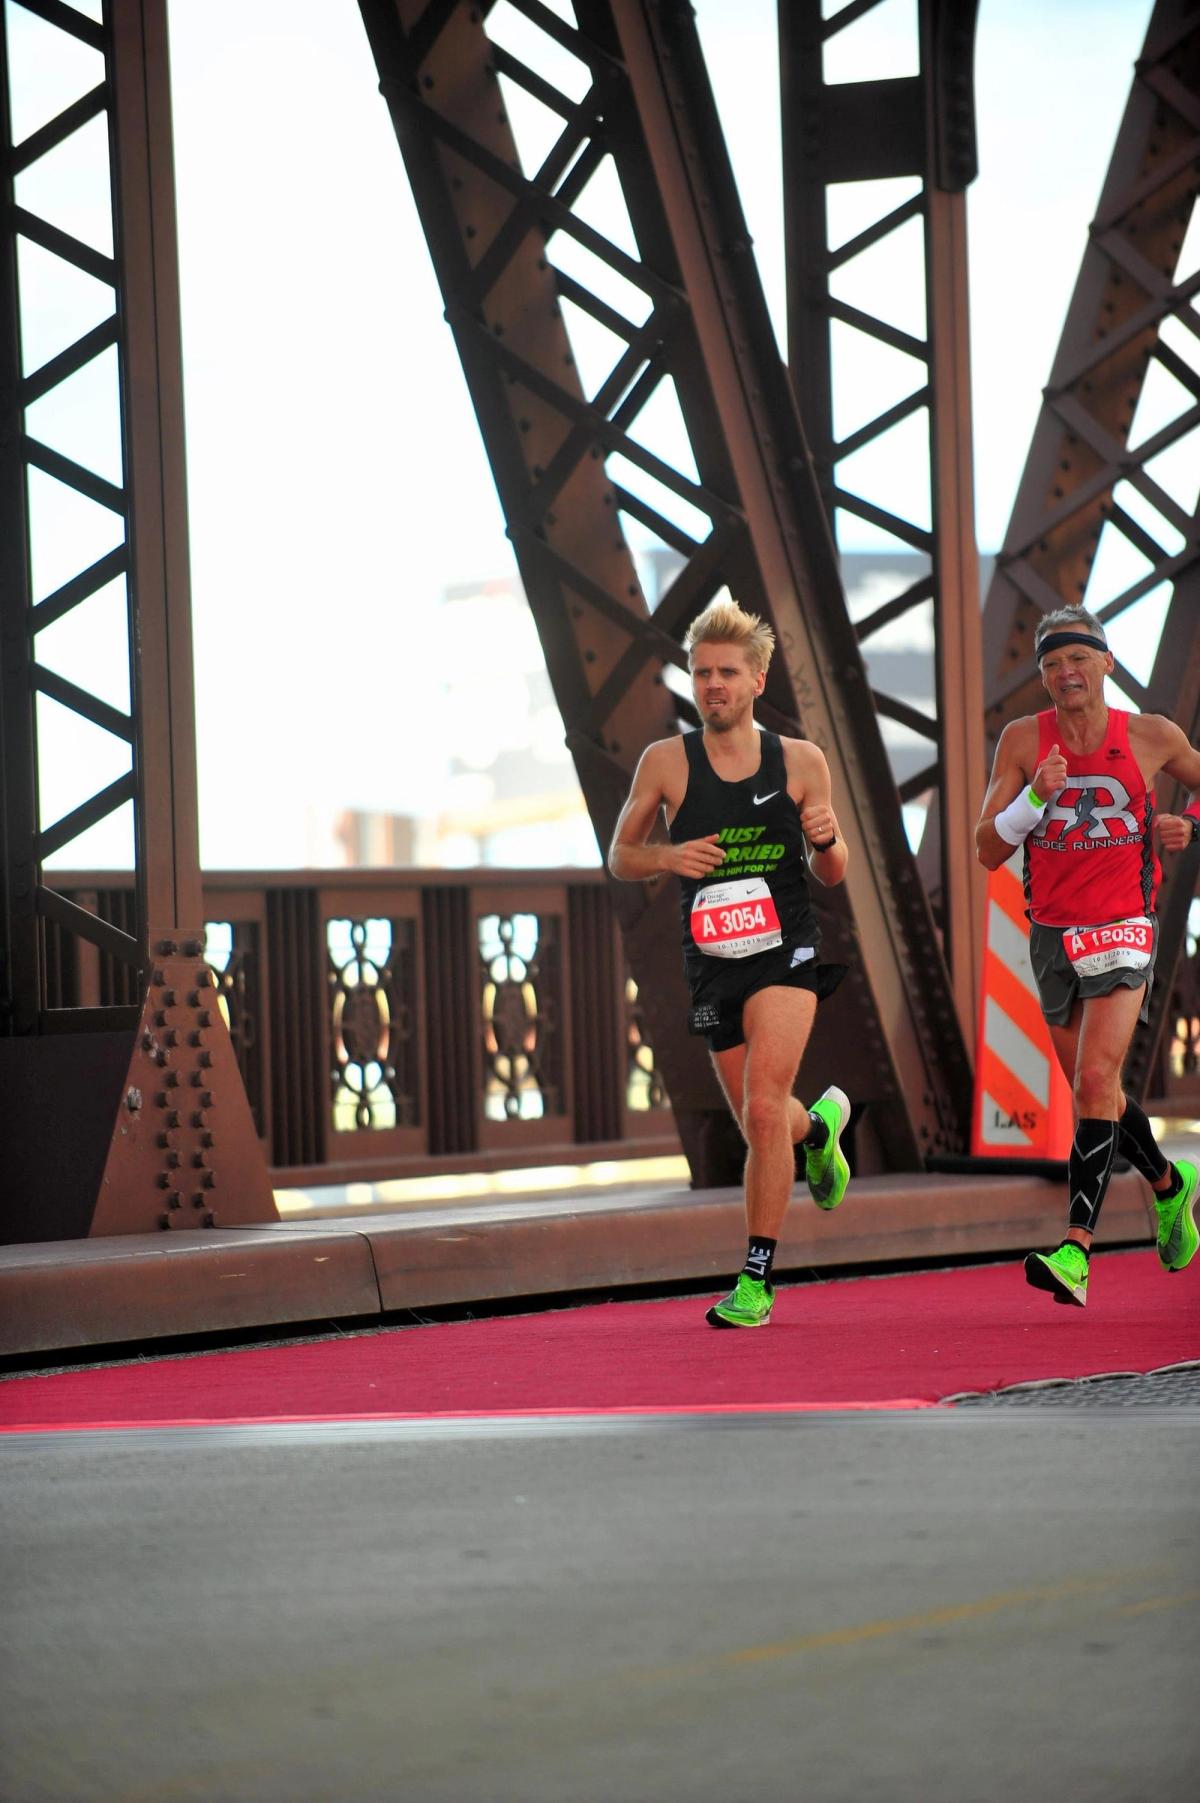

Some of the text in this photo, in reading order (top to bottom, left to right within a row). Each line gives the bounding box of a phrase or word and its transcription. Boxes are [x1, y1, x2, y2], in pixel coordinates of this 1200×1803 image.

[716, 826, 767, 844] JUST
[1073, 834, 1143, 851] RUNNERS
[724, 844, 785, 863] RRIED
[744, 863, 764, 873] FOR
[703, 904, 767, 938] A 3054
[1072, 927, 1147, 955] A 12053
[995, 1110, 1037, 1130] LAS
